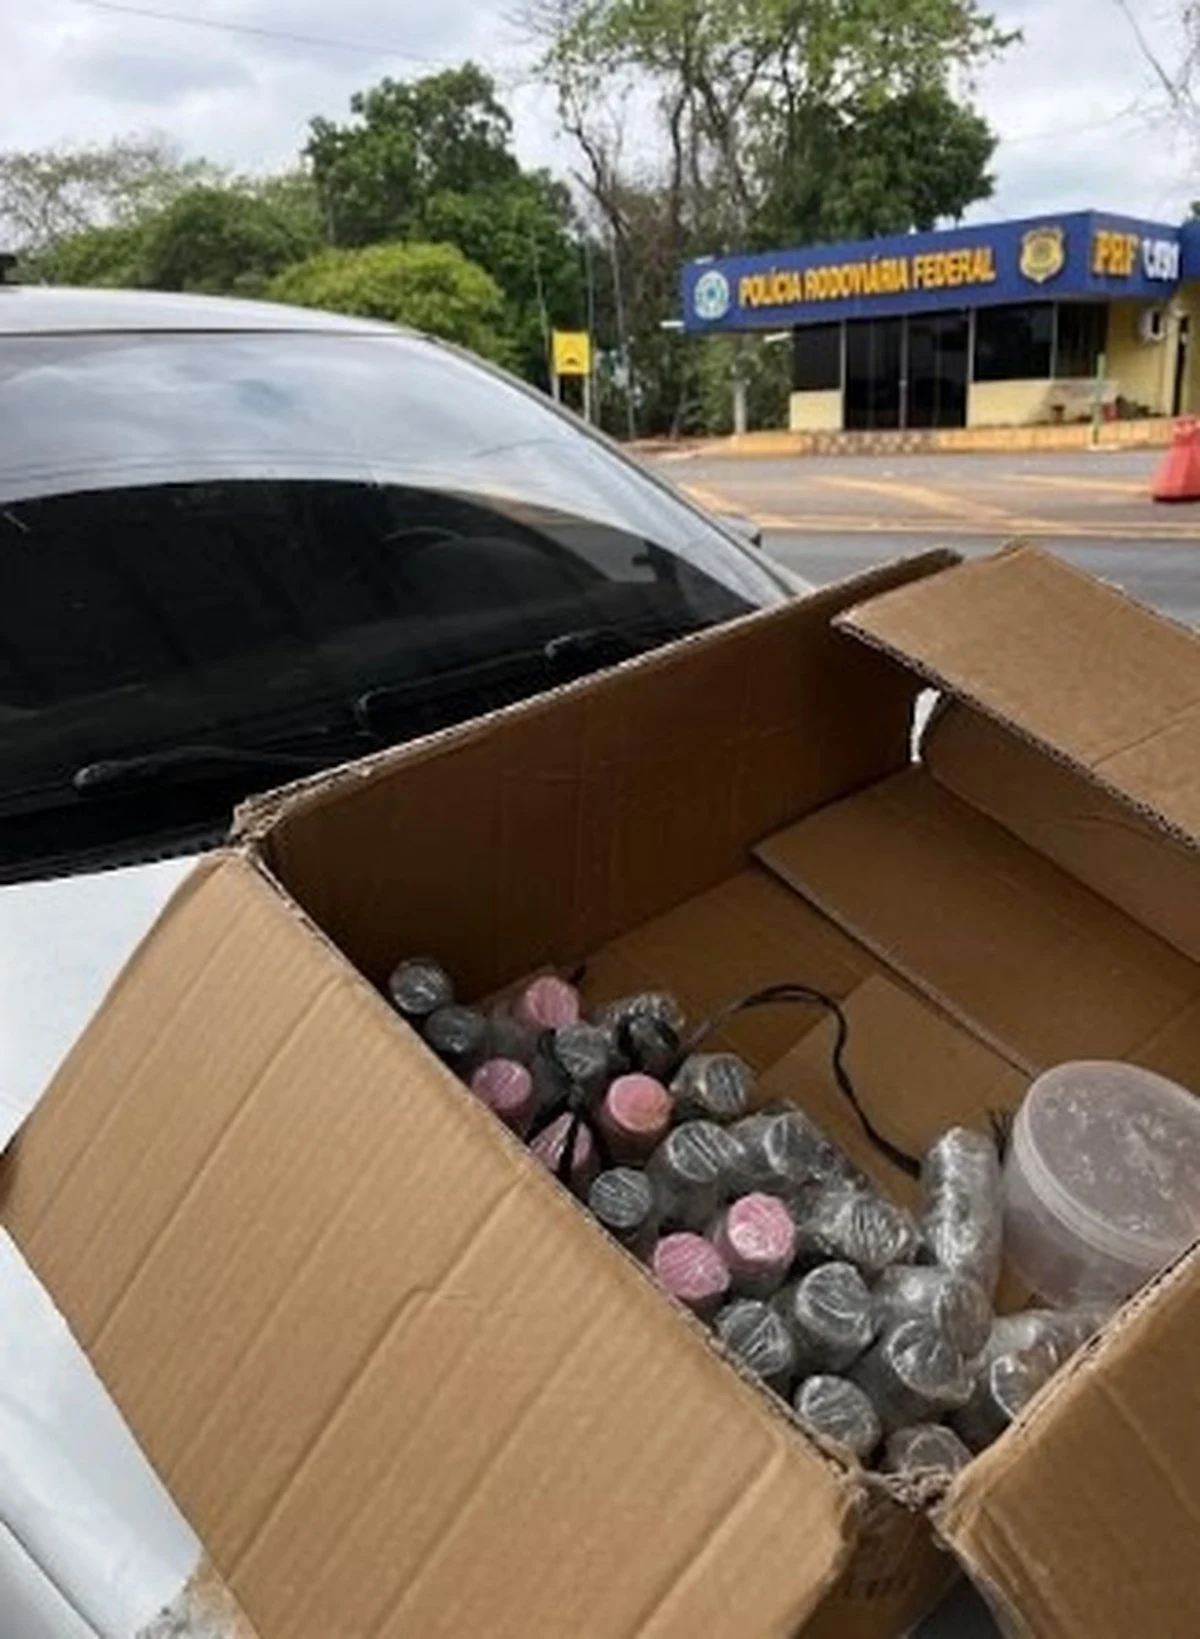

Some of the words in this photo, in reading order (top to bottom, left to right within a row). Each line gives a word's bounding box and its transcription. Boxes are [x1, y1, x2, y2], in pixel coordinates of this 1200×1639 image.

[739, 266, 802, 307] POLÍCIA
[804, 254, 908, 301] RODOVIÁRIA
[913, 247, 996, 289] FEDERAL
[1092, 230, 1139, 276] PRF
